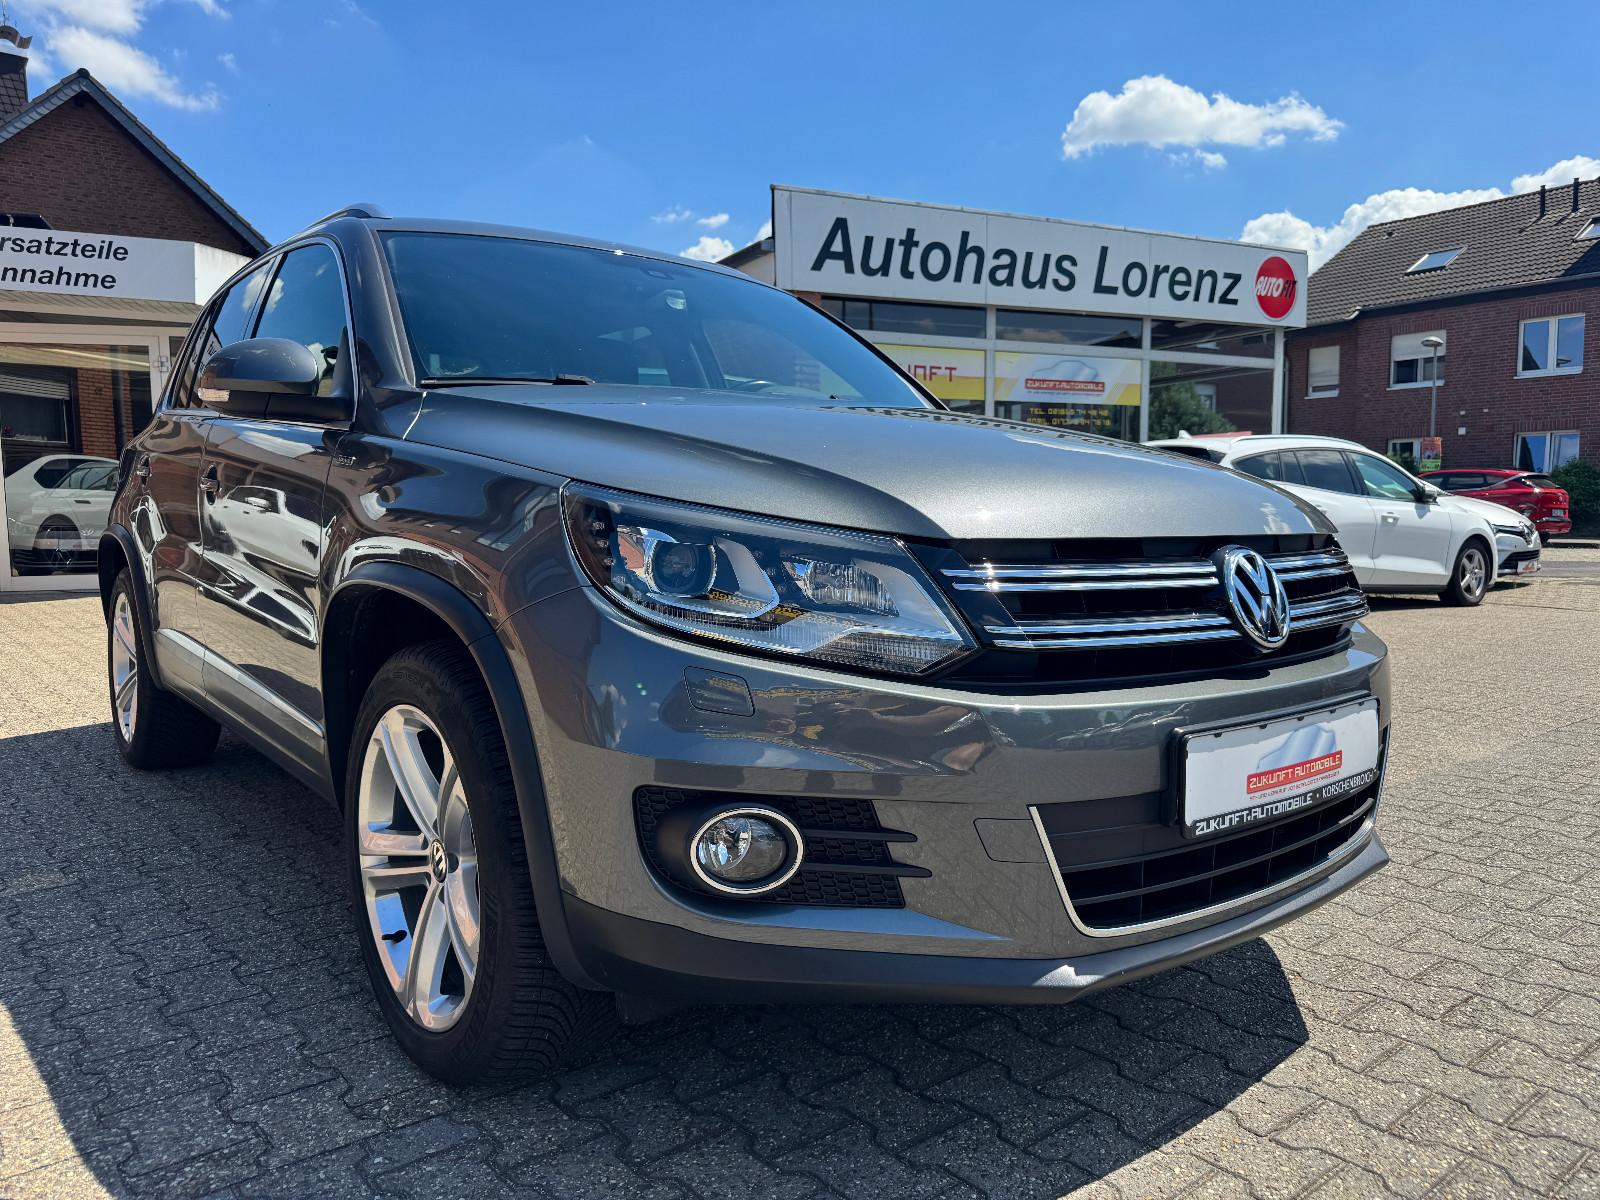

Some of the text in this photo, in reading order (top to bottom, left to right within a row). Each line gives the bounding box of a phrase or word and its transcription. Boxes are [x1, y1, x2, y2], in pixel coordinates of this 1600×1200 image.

[0, 236, 129, 261] rsatzteile
[810, 217, 1242, 306] Autohaus Lorenz
[0, 266, 117, 290] nnahme
[1249, 768, 1294, 789] ZUKUNFT
[1294, 754, 1341, 777] AUTOMOBILE
